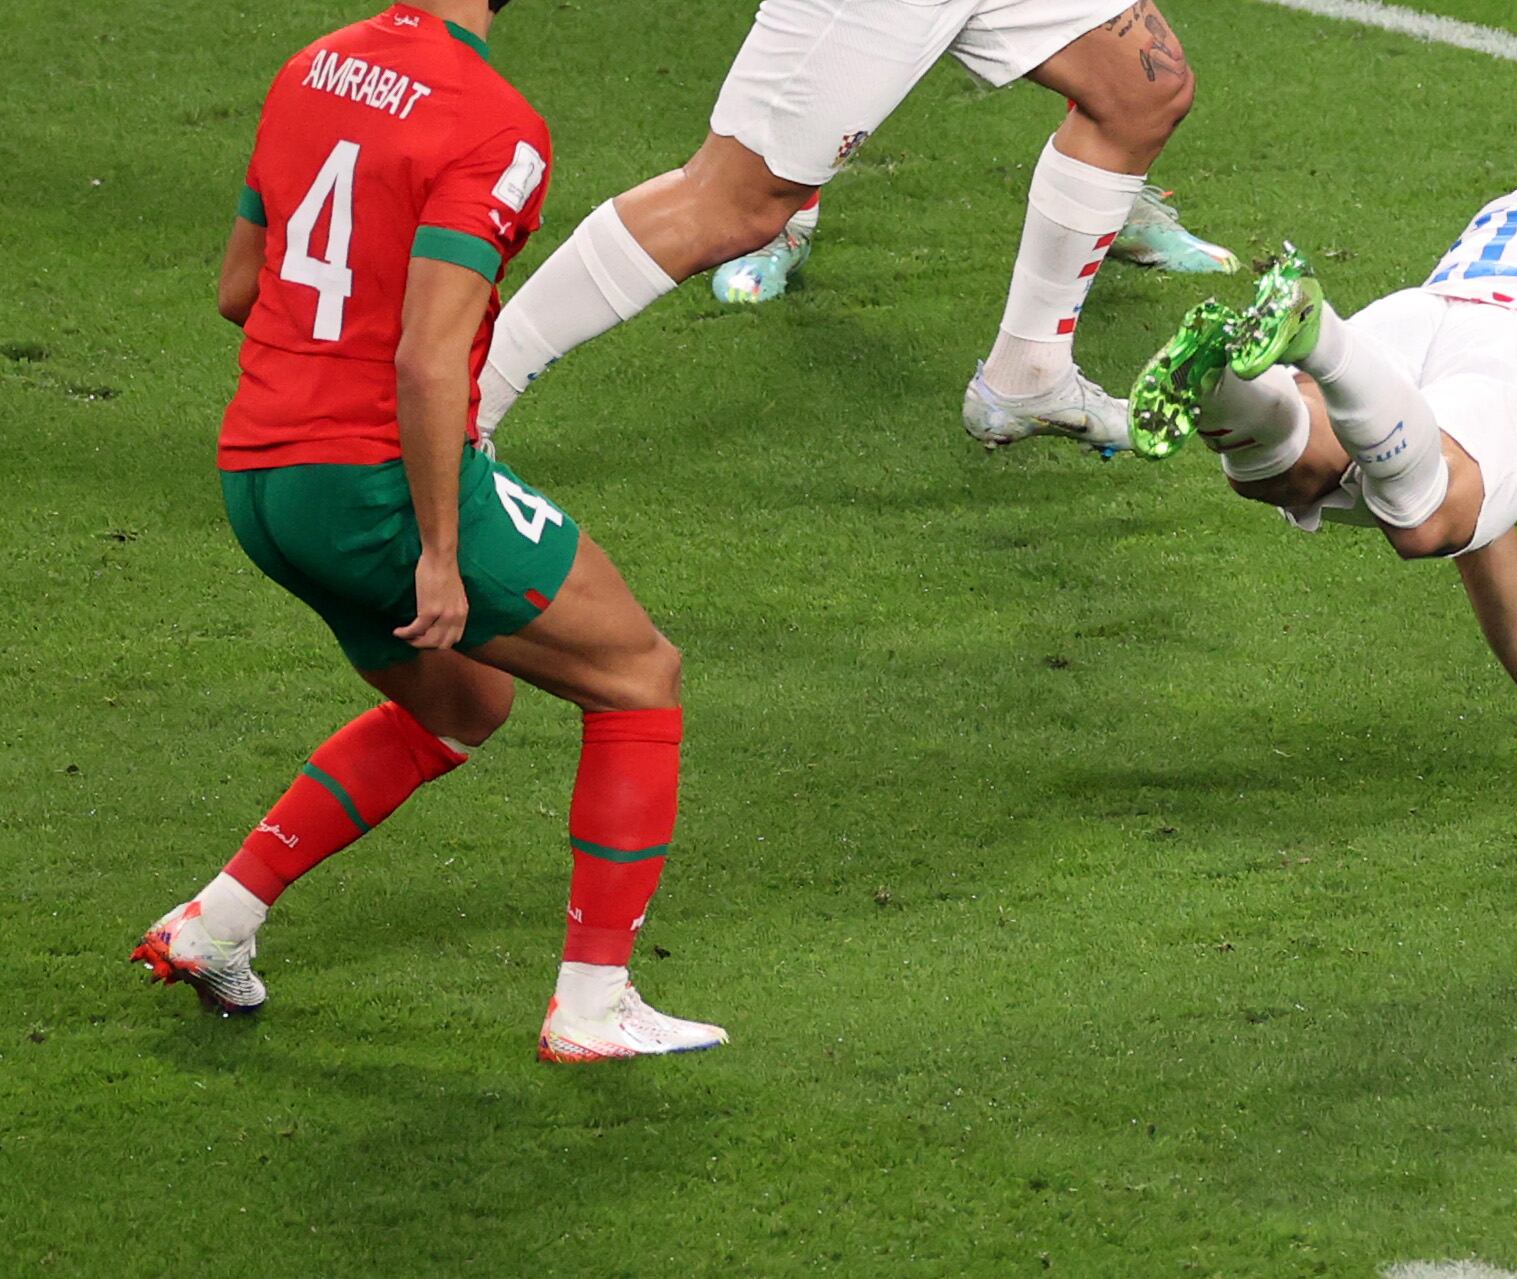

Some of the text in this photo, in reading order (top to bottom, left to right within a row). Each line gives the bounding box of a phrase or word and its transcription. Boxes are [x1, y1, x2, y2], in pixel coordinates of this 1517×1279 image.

[302, 48, 432, 119] AMRABAT
[280, 139, 361, 341] 4
[494, 472, 563, 544] 4
